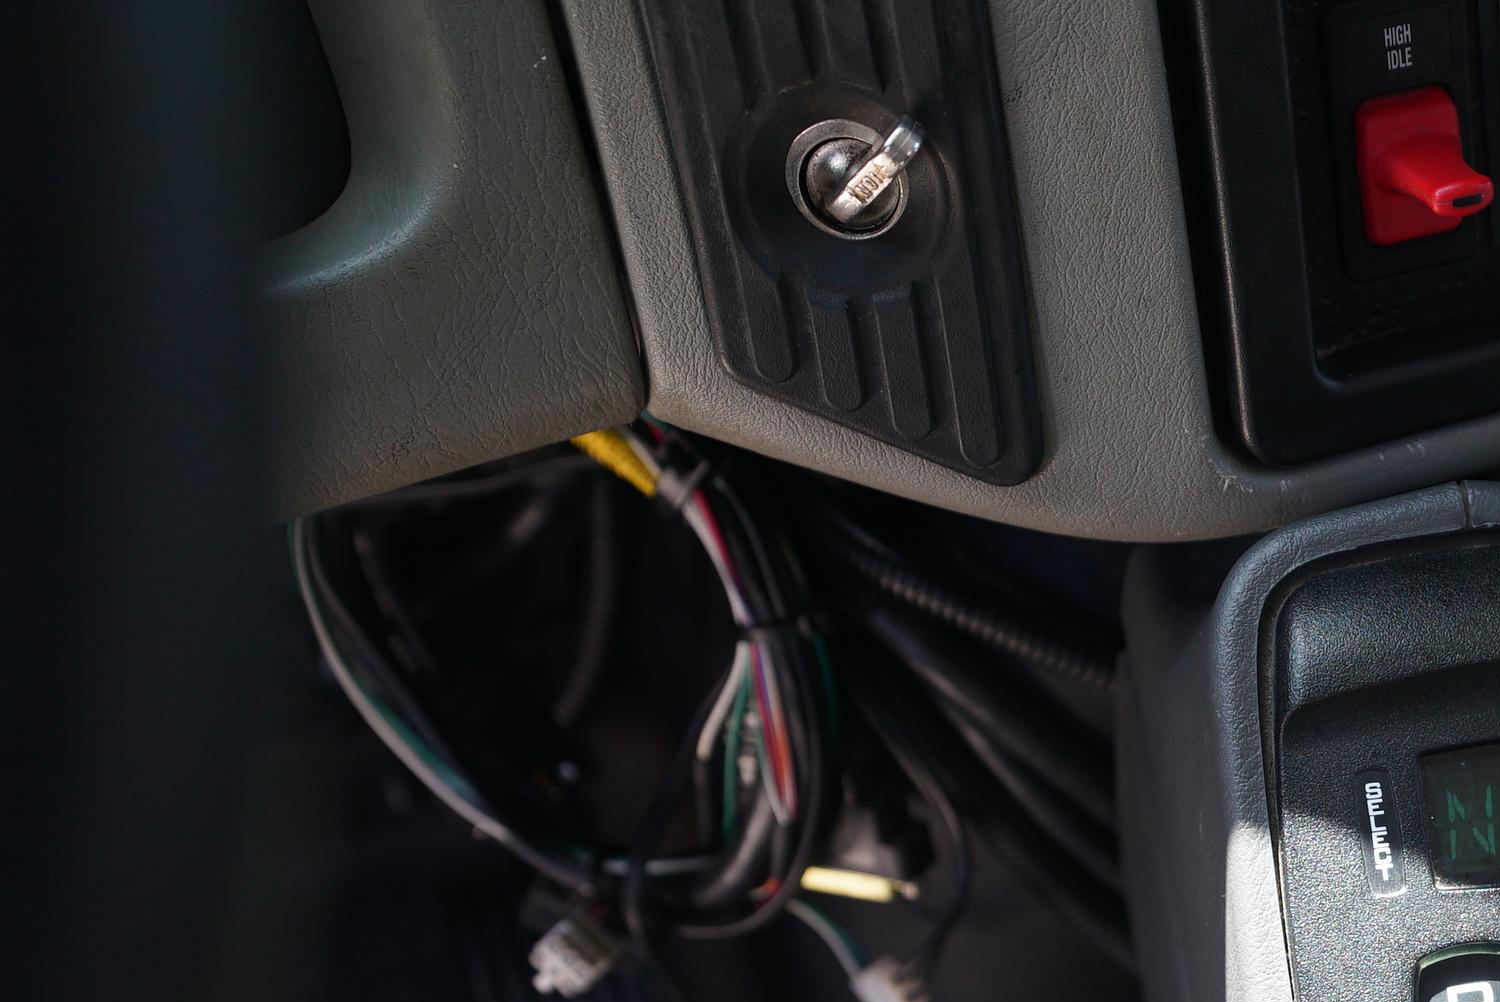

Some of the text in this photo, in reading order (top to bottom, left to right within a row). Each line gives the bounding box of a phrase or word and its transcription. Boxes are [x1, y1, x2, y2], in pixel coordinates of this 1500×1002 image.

[1384, 23, 1412, 48] HIGH
[1387, 47, 1413, 70] IDLE
[1365, 782, 1393, 881] SELECT
